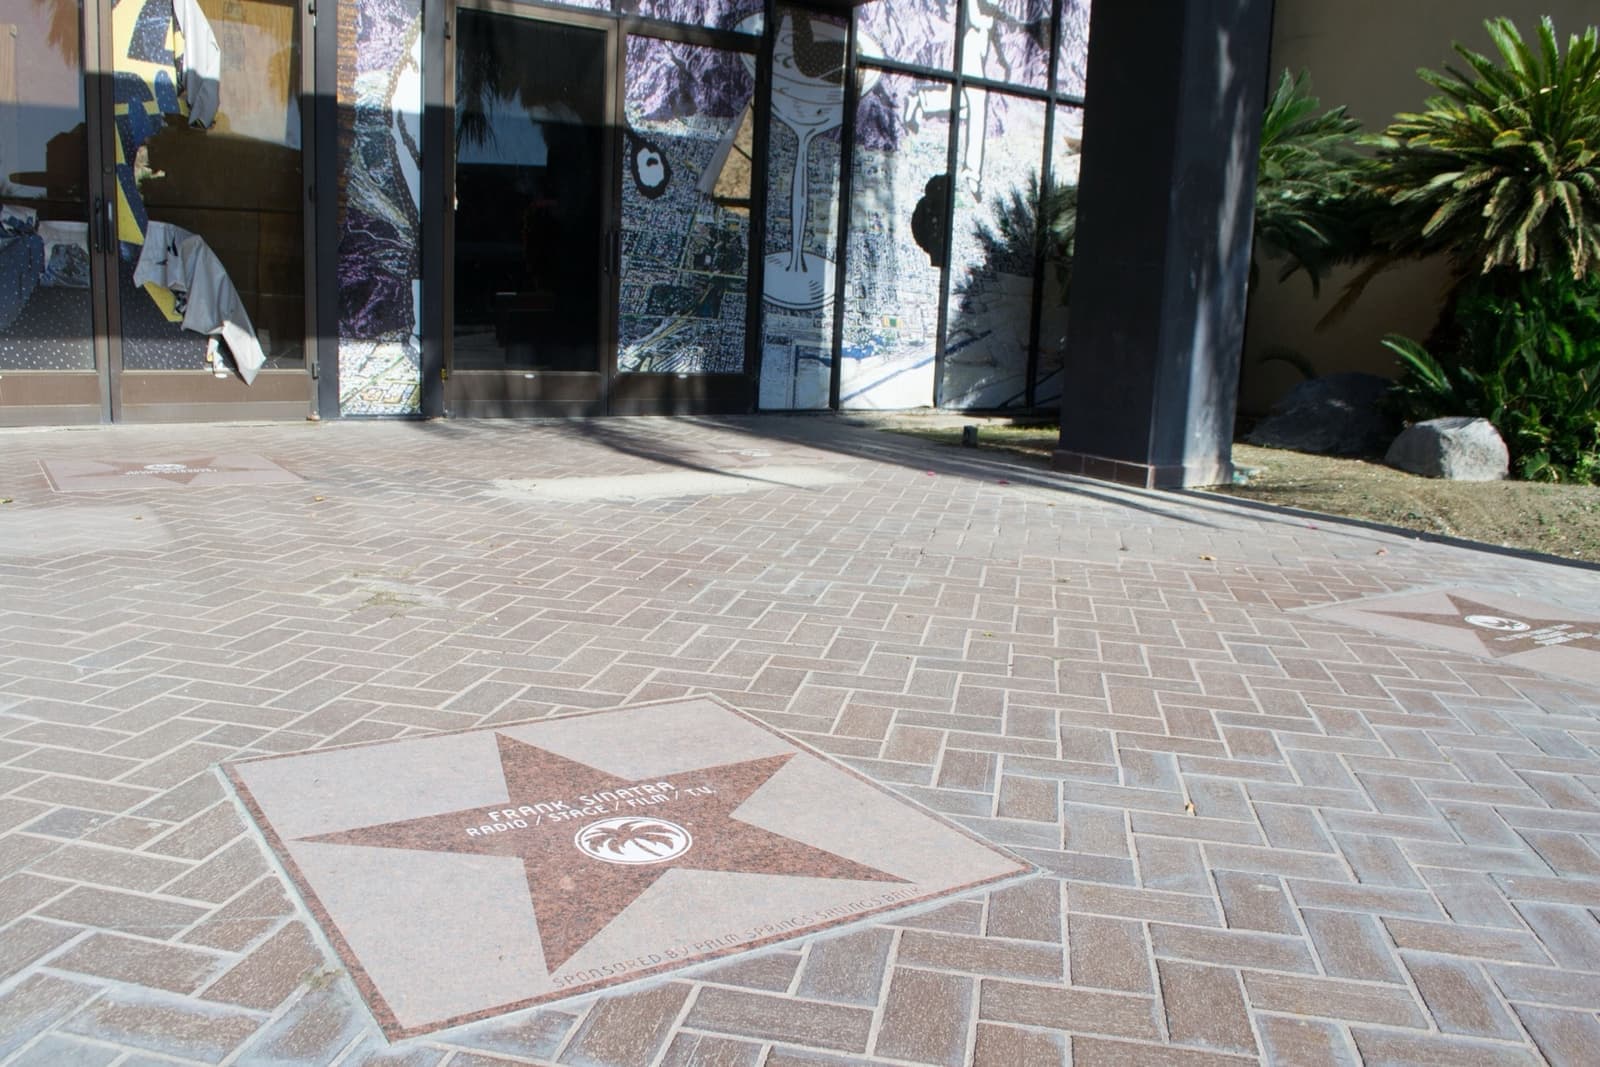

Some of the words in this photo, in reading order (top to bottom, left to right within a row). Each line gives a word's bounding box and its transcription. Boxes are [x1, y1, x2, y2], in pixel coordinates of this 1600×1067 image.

[466, 819, 528, 838] RADIO
[536, 816, 542, 825] /
[552, 804, 609, 822] STAGE
[615, 801, 620, 811] /
[628, 794, 670, 808] FILM
[674, 790, 680, 800] /
[488, 800, 570, 821] FRANK
[579, 782, 676, 806] SINATRA
[552, 953, 662, 988] SPONSORED
[665, 945, 689, 959] BY
[694, 933, 740, 951] PALM
[746, 914, 815, 938] SPRINGS
[816, 897, 882, 919] SAVINGS
